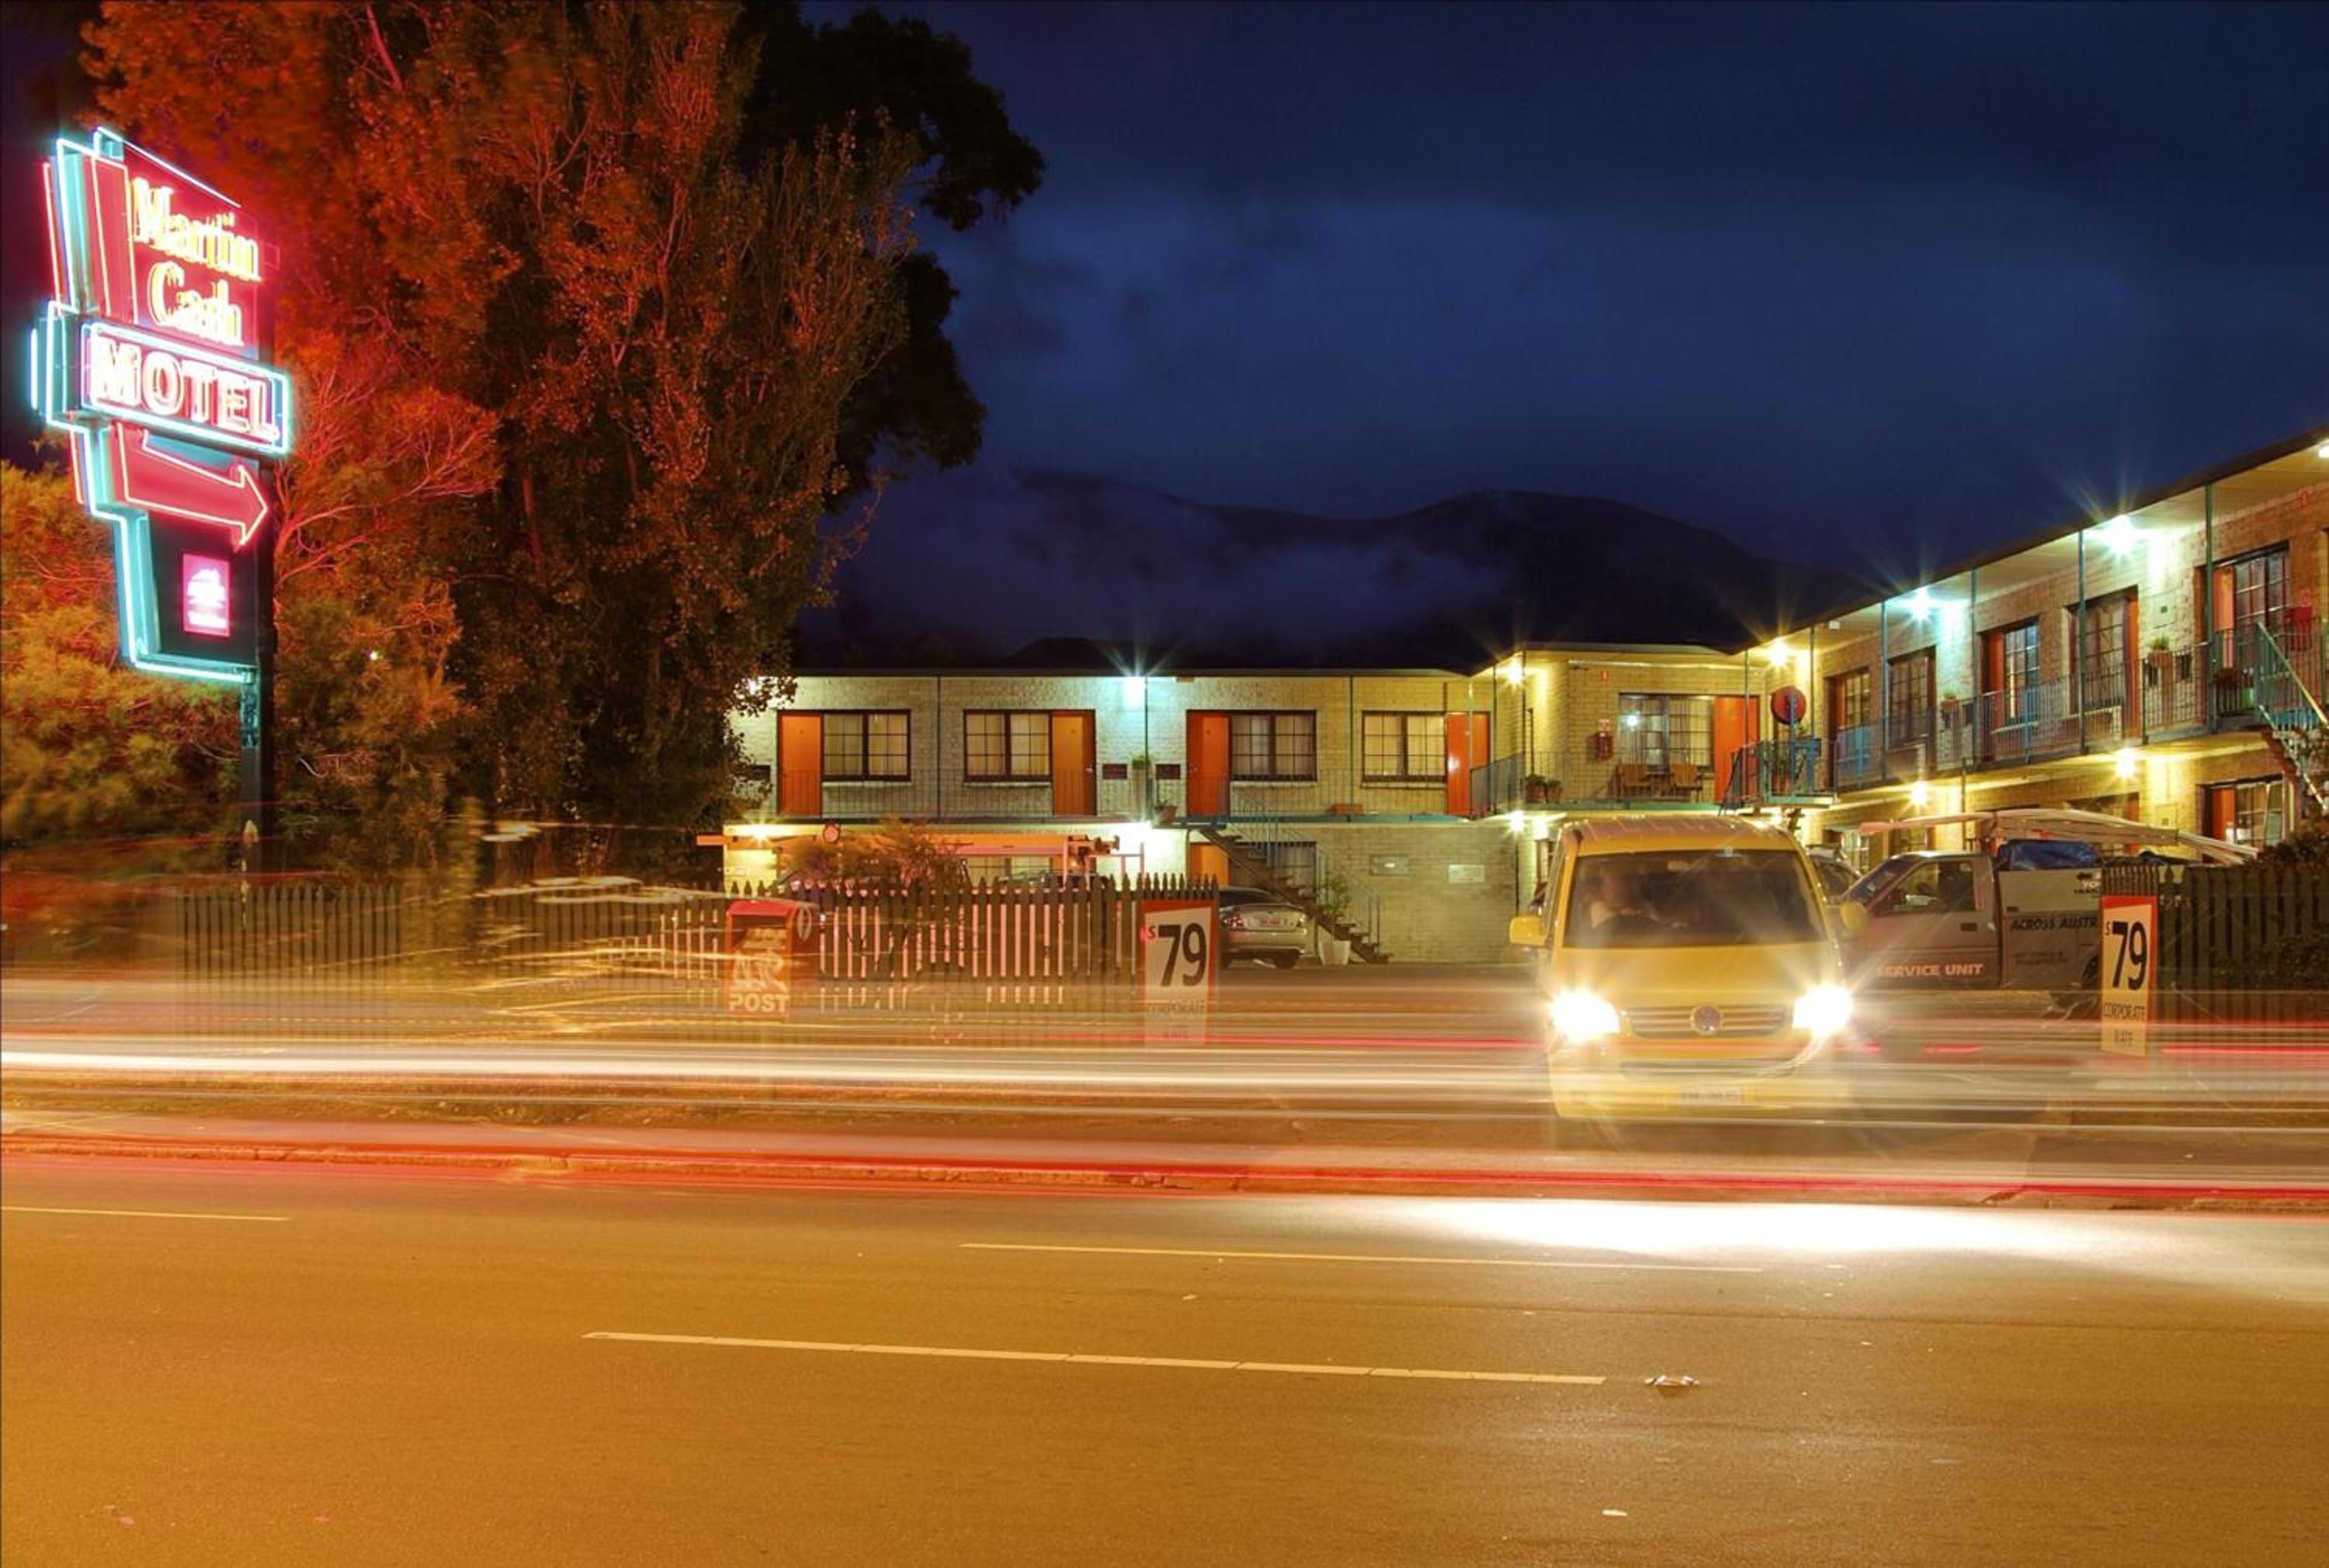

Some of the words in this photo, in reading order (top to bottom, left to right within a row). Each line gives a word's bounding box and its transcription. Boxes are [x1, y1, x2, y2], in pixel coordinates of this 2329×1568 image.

[132, 176, 262, 283] Martin
[91, 335, 280, 441] MOTEL
[2011, 918, 2055, 931] ACROSS
[1876, 963, 1940, 978] SERVICE
[1945, 963, 1984, 976] UNIT
[728, 993, 790, 1013] POST
